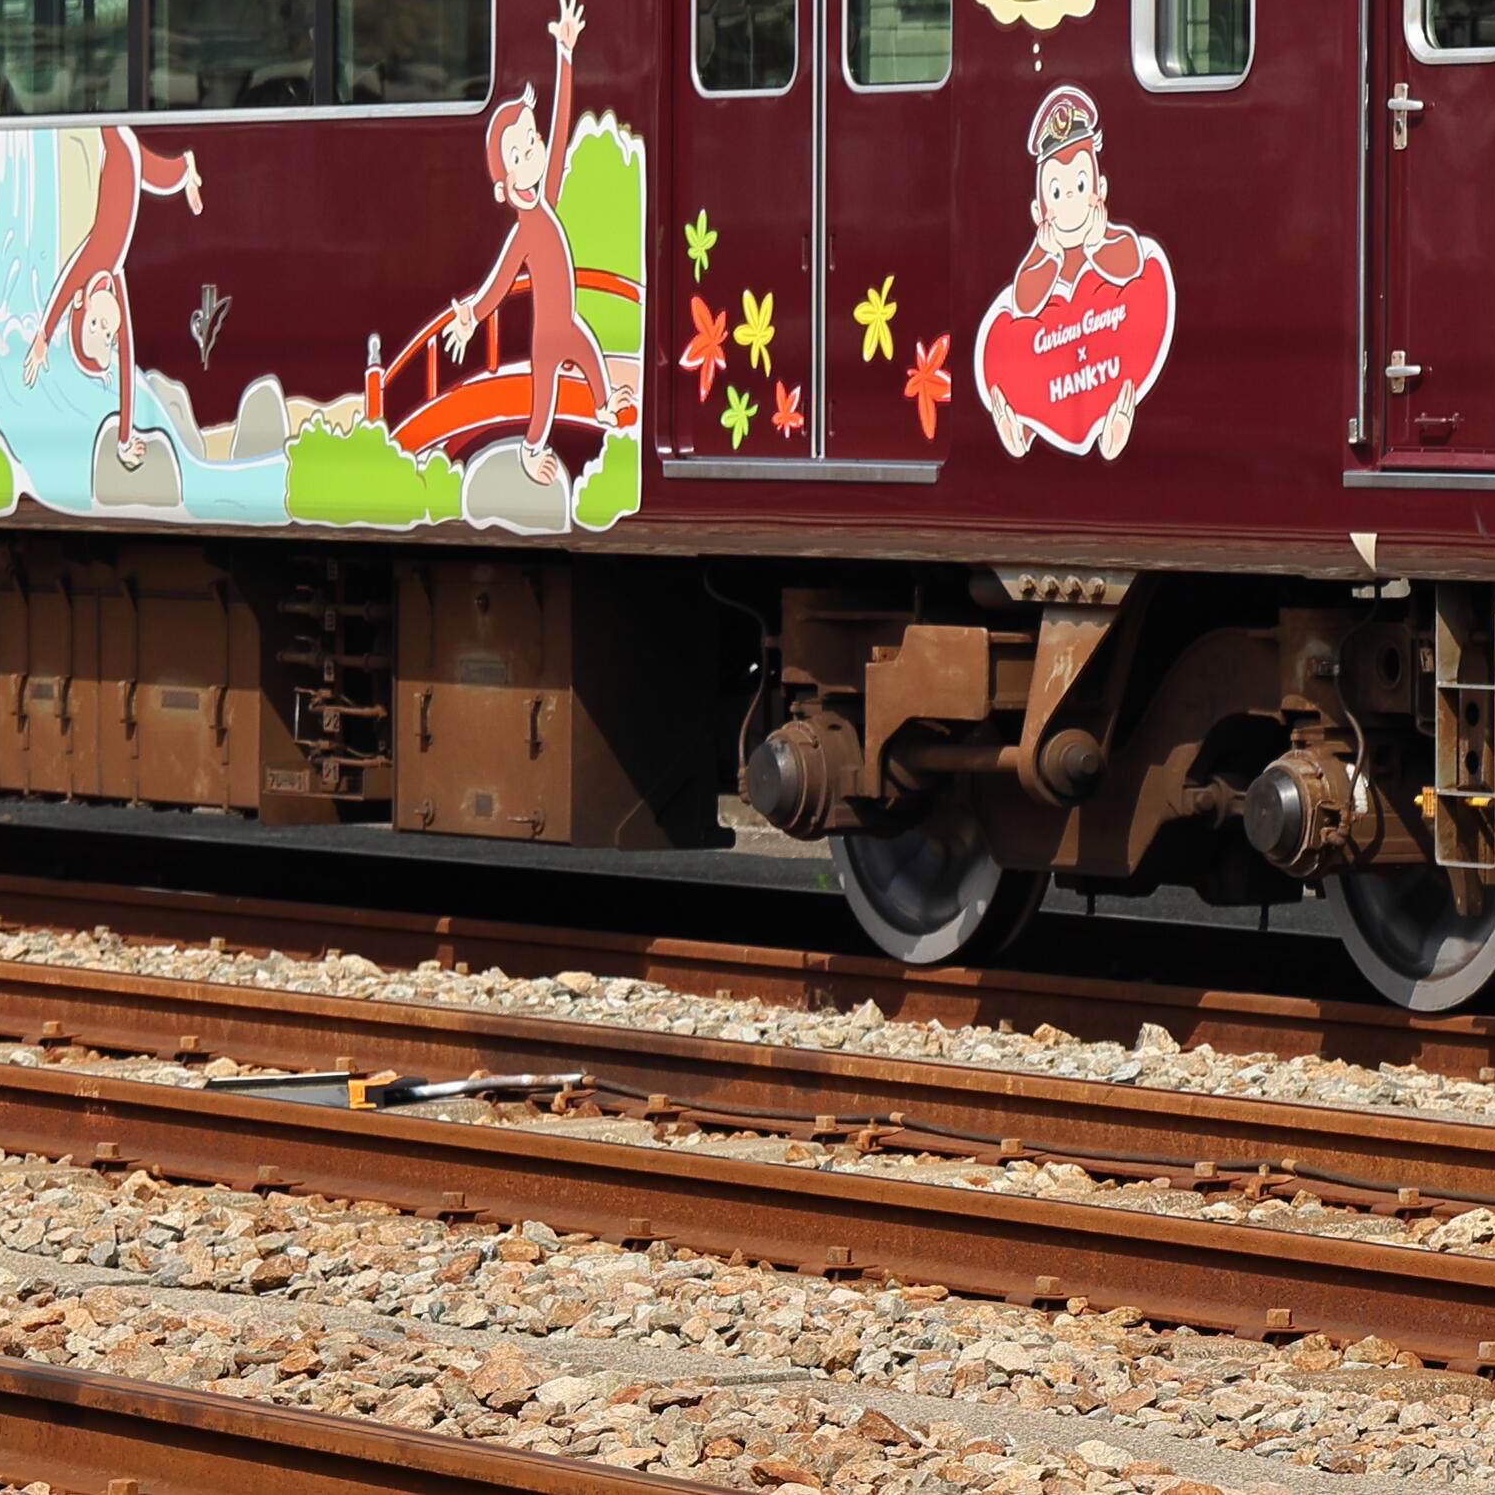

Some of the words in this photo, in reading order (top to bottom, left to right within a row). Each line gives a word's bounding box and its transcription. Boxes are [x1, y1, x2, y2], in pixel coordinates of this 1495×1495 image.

[1033, 324, 1082, 355] Curious
[1082, 304, 1127, 335] George
[1049, 355, 1120, 403] HANKYU
